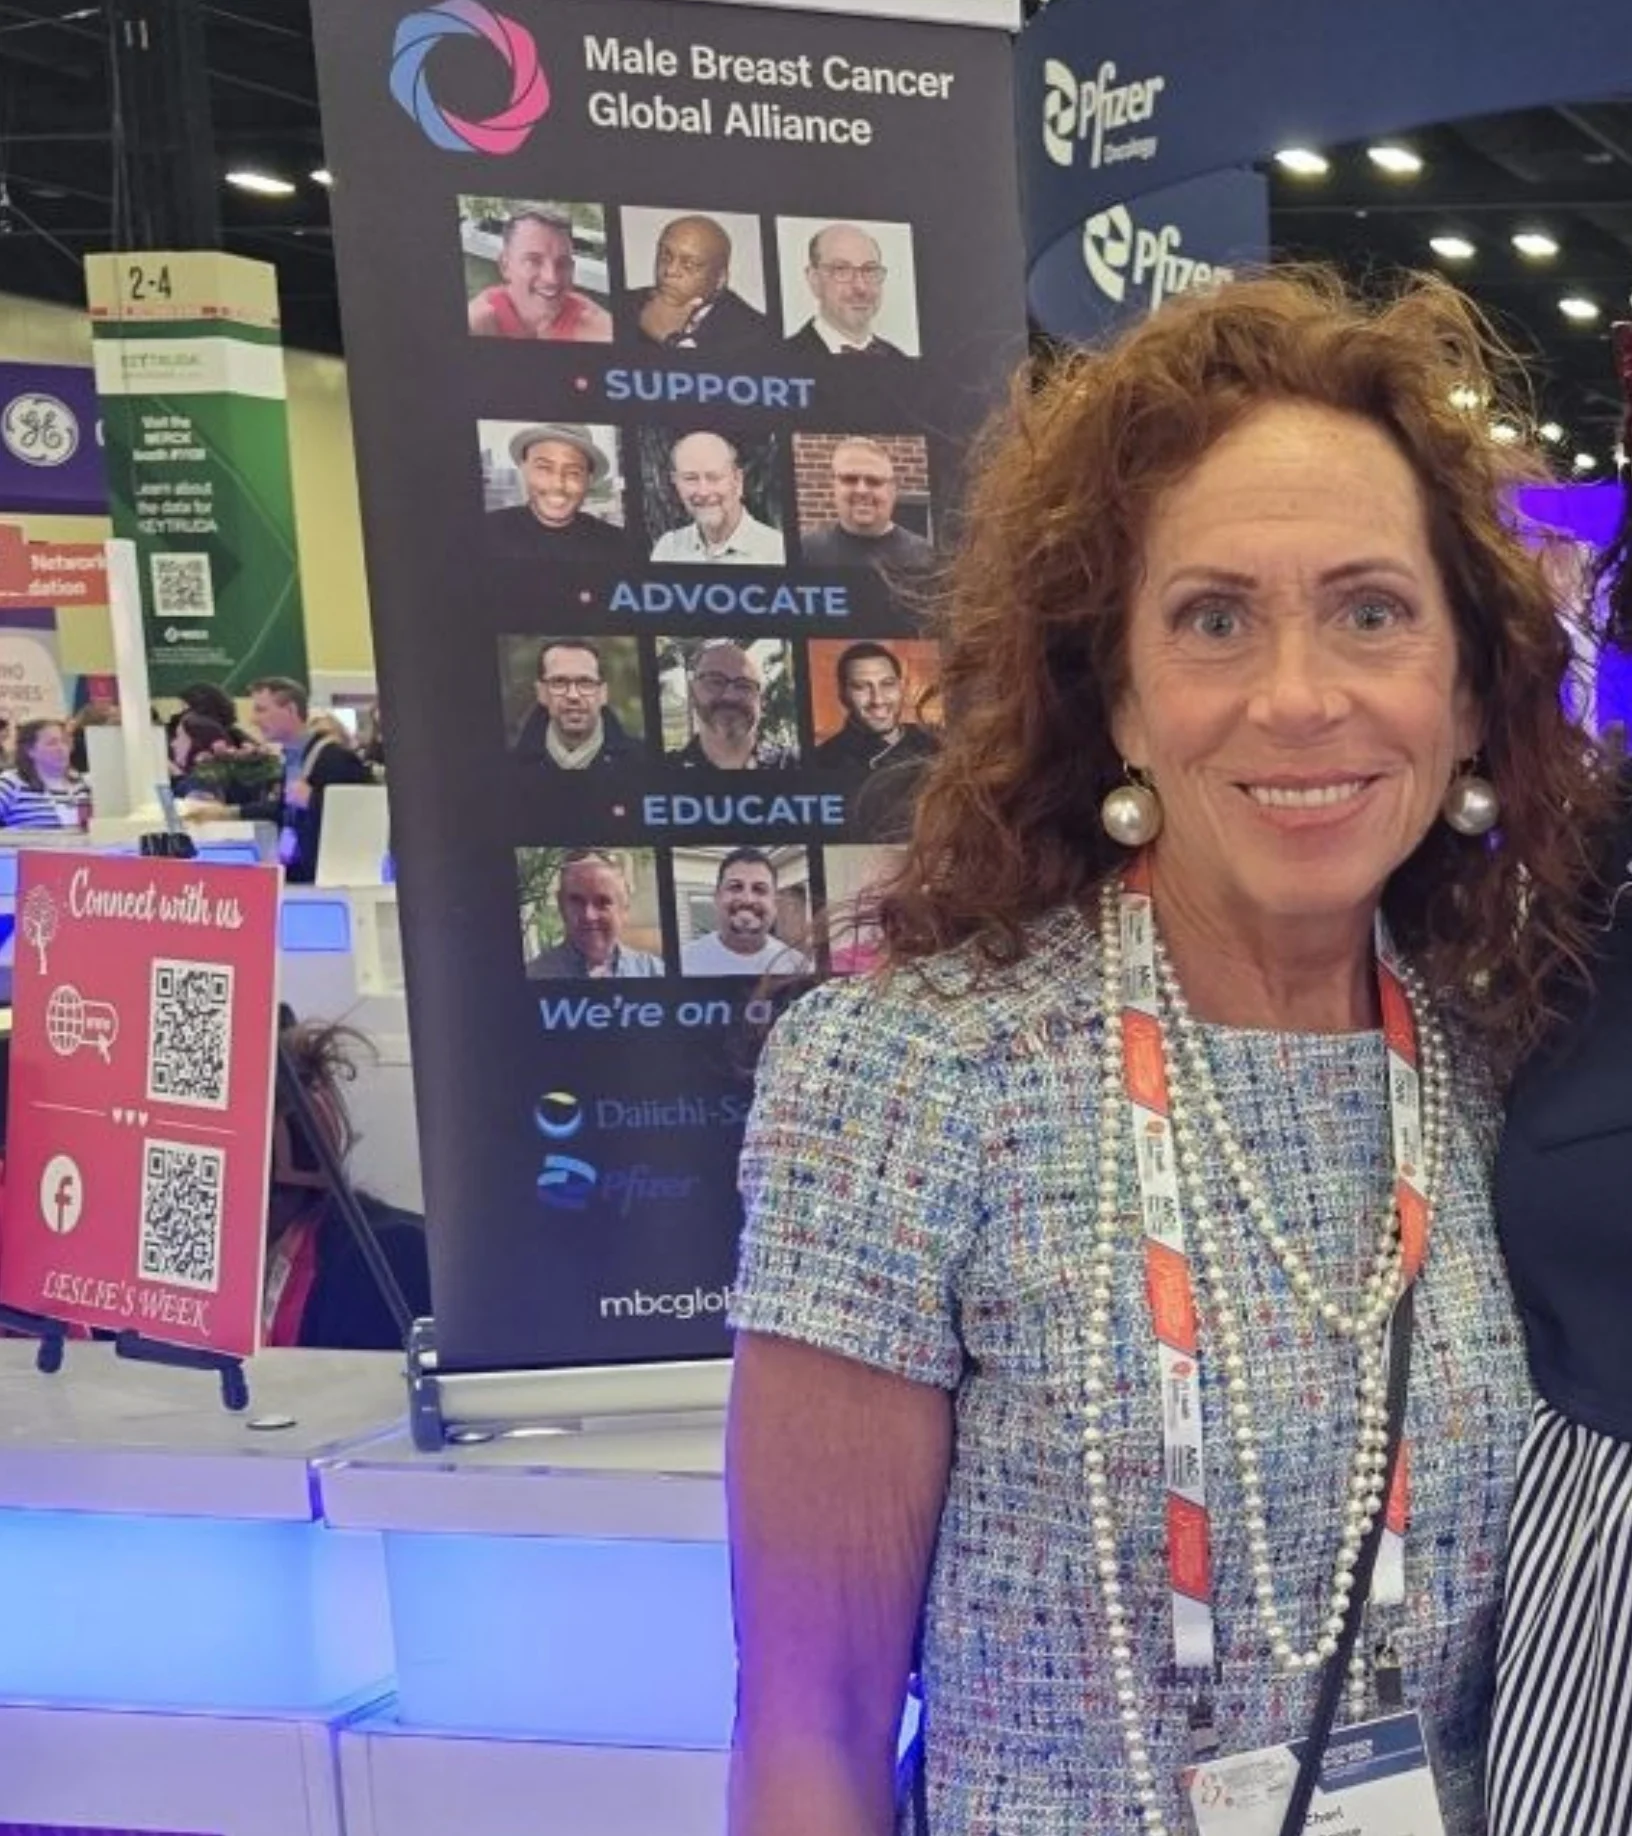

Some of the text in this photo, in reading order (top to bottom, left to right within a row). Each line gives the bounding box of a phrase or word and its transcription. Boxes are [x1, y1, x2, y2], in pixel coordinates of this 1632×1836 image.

[584, 35, 954, 100] Male Breast Cancer
[588, 92, 872, 146] Global Alliance
[1079, 61, 1165, 169] Pfizer
[129, 266, 172, 300] 2-4
[605, 369, 816, 409] SUPPORT
[609, 582, 850, 617] ADVOCATE
[642, 795, 845, 826] EDUCATE
[69, 866, 244, 930] Connect with us
[539, 994, 773, 1031] We're on a
[138, 1288, 212, 1338] WEEK
